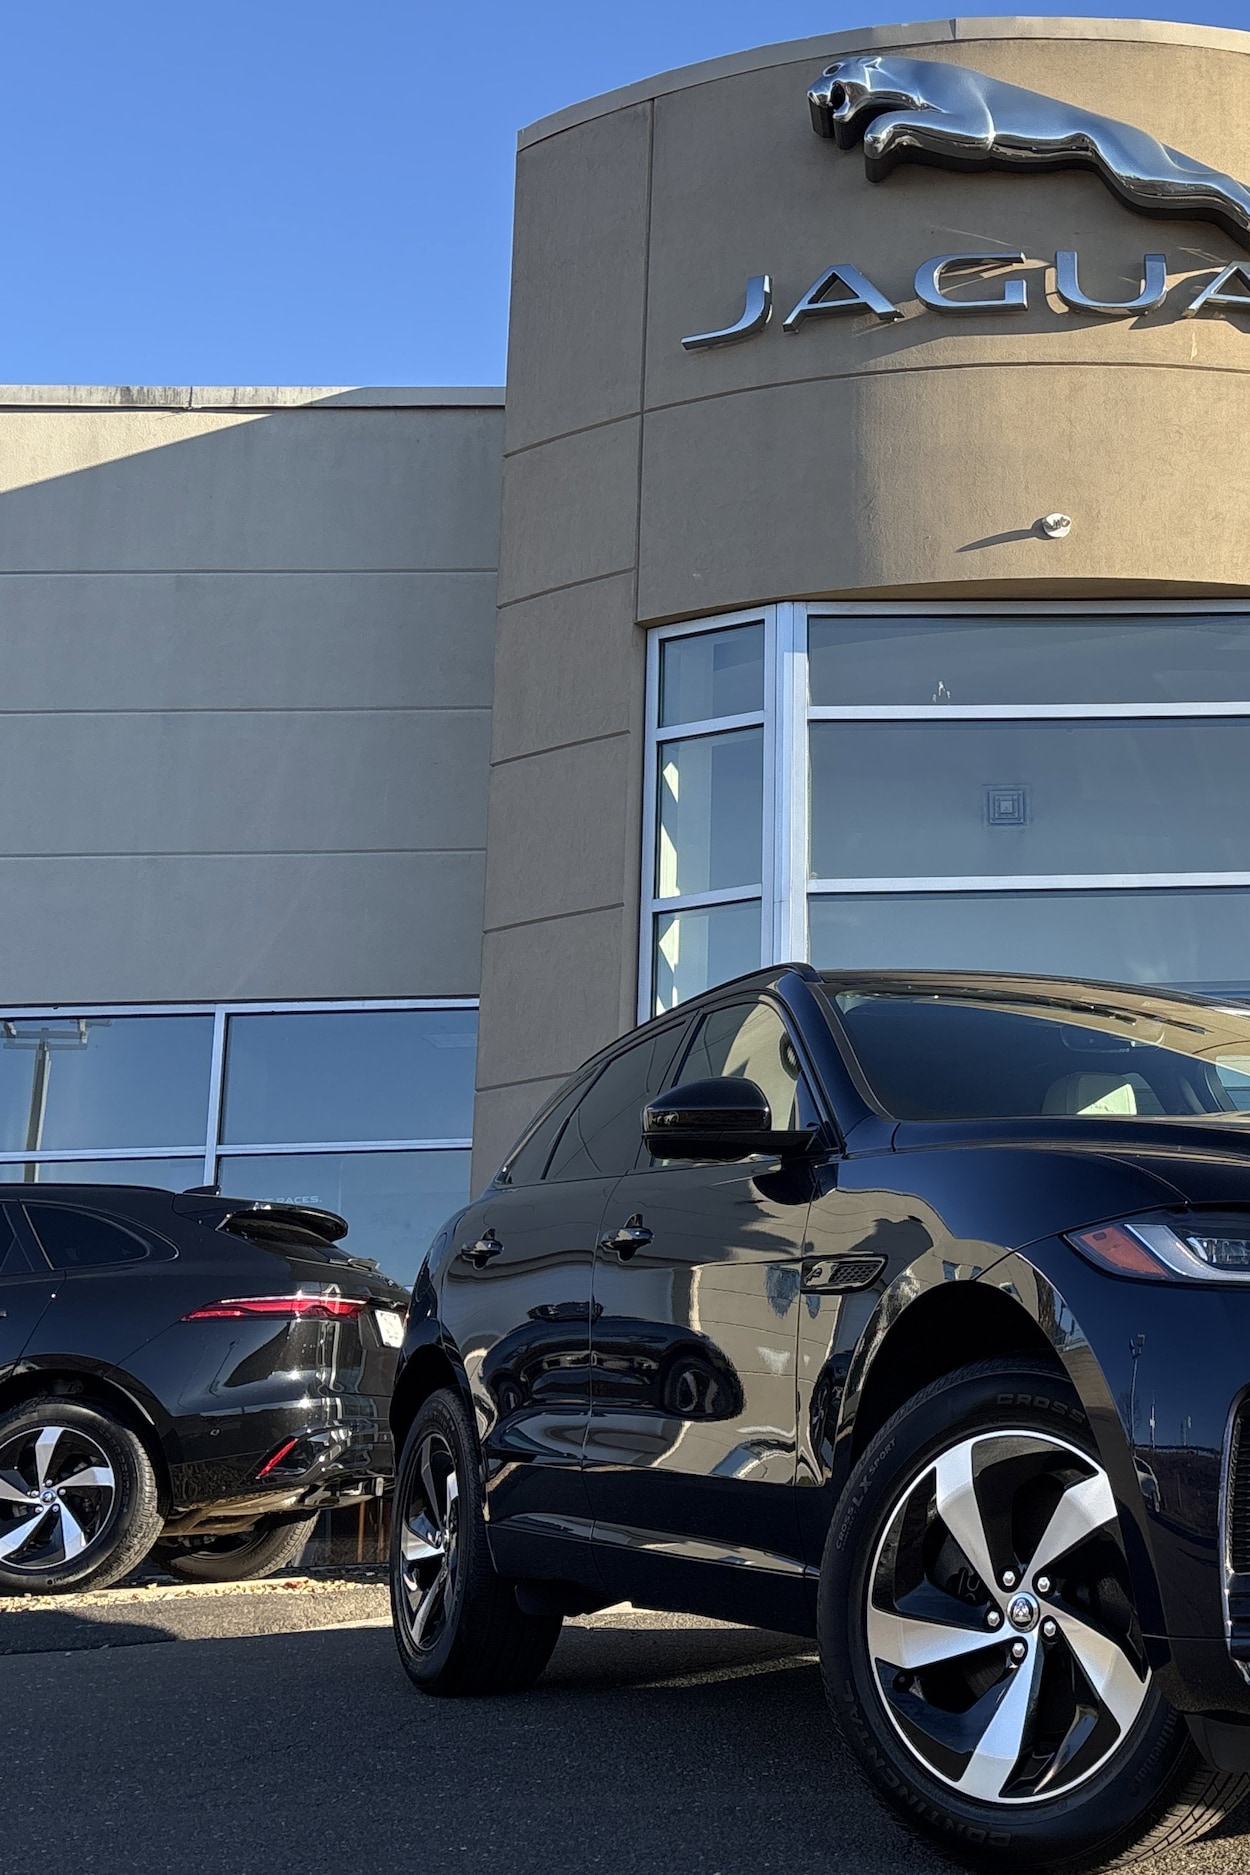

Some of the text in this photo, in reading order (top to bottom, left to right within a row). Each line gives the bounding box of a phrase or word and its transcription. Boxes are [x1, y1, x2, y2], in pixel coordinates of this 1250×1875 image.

[997, 1393, 1086, 1425] CROSS
[835, 1505, 854, 1550] CROSS
[869, 1438, 896, 1475] SPORT
[842, 1679, 1012, 1848] CONTINENTAL
